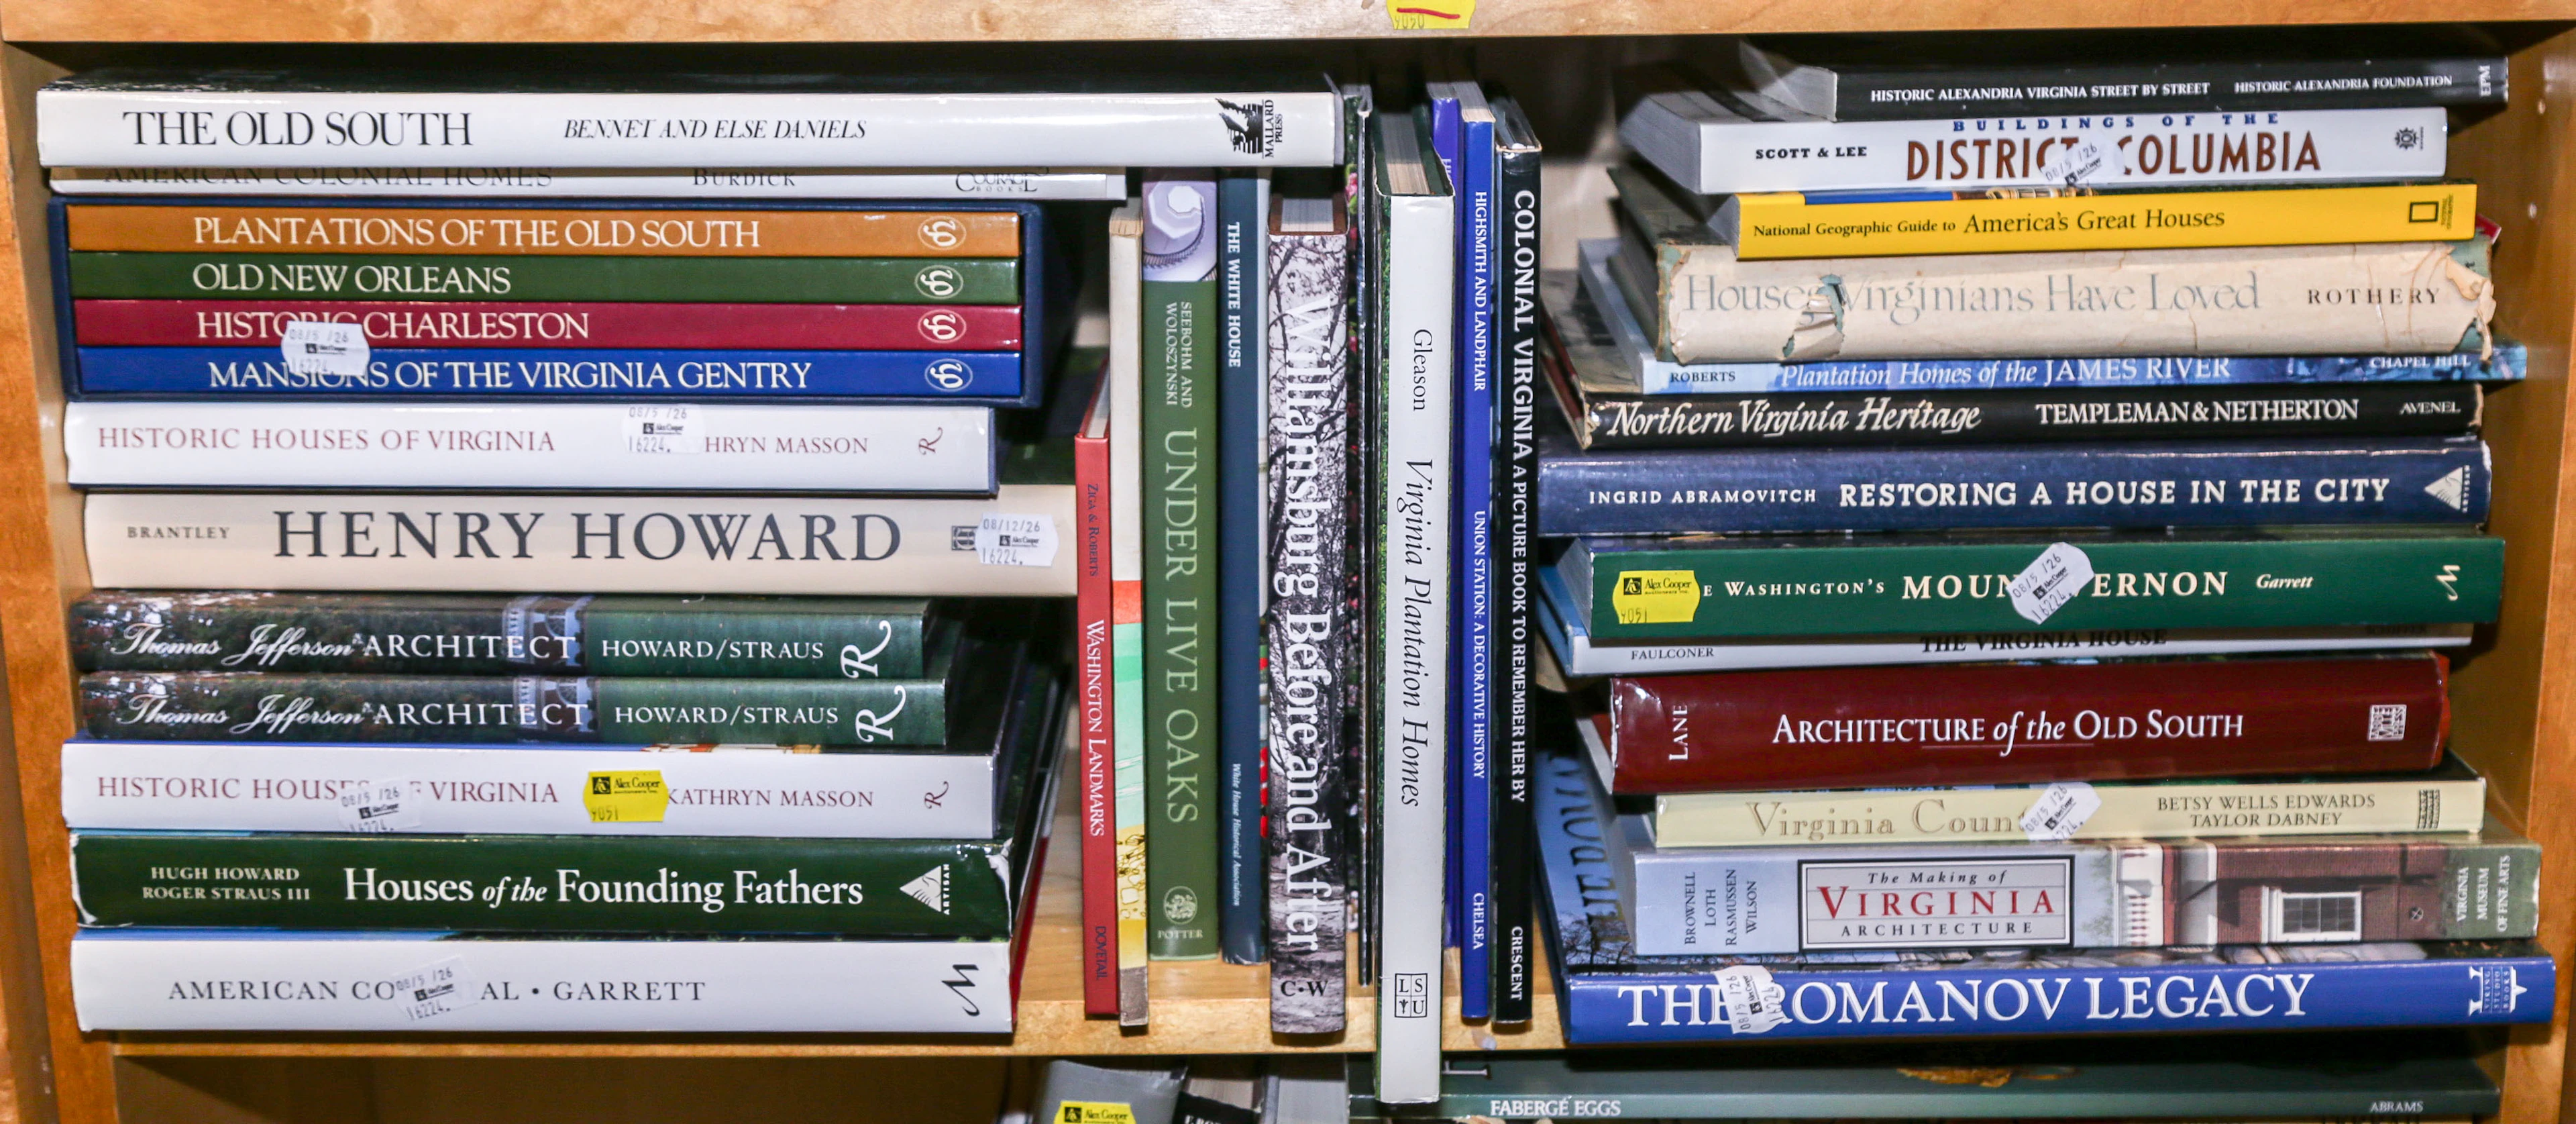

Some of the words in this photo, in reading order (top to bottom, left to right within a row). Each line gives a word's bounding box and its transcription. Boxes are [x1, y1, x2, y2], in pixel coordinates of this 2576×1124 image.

[1871, 89, 1935, 102] HISTORIC
[1938, 87, 2023, 101] ALEXANDRIA
[2027, 86, 2087, 99] VIRGINIA
[2091, 85, 2138, 97] STREET
[2146, 84, 2160, 96] BY
[2163, 82, 2210, 95] STREET
[2235, 81, 2292, 93] HISTORIC
[2294, 78, 2369, 91] ALEXANDRIA
[2373, 75, 2453, 89] FOUNDATION
[123, 111, 216, 146] THE
[226, 111, 313, 146] OLD
[325, 111, 472, 146] SOUTH
[565, 119, 653, 140] BENNET
[660, 119, 706, 140] AND
[714, 119, 767, 140] ELSE
[774, 119, 867, 140] DANIELS
[1265, 99, 1275, 158] MALLARD
[1954, 117, 2134, 132] BUILDINGS
[2163, 114, 2196, 127] OF
[2222, 113, 2278, 125] THE
[1756, 147, 1811, 159] SCOTT
[1817, 147, 1830, 158] &
[1836, 146, 1868, 157] LEE
[195, 217, 433, 246] PLANTATIONS
[441, 218, 485, 246] OF
[490, 219, 558, 246] THE
[565, 219, 635, 248] OLD
[641, 219, 761, 248] SOUTH
[1228, 222, 1240, 252] THE
[1475, 191, 1487, 272] HIGHSMITH
[1754, 223, 1811, 237] National
[1816, 220, 1892, 238] Geographic
[1897, 219, 1937, 233] Guide
[1943, 219, 1955, 231] to
[1964, 211, 2068, 234] America's
[2078, 209, 2136, 232] Great
[2145, 209, 2225, 229] Houses
[193, 264, 262, 291] OLD
[270, 265, 348, 292] NEW
[355, 265, 511, 294] ORLEANS
[1513, 191, 1536, 332] COLONIAL
[1228, 258, 1241, 309] WHITE
[1474, 276, 1487, 308] AND
[2047, 274, 2135, 313] Have
[2150, 272, 2259, 311] Loved
[2308, 288, 2439, 305] ROTHERY
[1181, 302, 1191, 370] SEEBOHM
[1228, 315, 1241, 368] HOUSE
[1474, 311, 1487, 391] LANDPHAIR
[395, 361, 438, 389] OF
[444, 362, 515, 389] THE
[522, 362, 671, 389] VIRGINIA
[678, 362, 812, 390] GENTRY
[1413, 329, 1433, 411] Gleason
[1670, 371, 1735, 382] ROBERTS
[1781, 364, 1890, 387] Plantation
[1898, 363, 1970, 385] Homes
[1978, 360, 2000, 389] of
[2004, 360, 2036, 382] the
[2045, 358, 2137, 384] JAMES
[2147, 357, 2231, 380] RIVER
[1181, 375, 1192, 408] AND
[1512, 338, 1534, 461] VIRGINIA
[2400, 401, 2461, 414] AVENEL
[1607, 401, 1733, 436] Northern
[1739, 399, 1849, 437] Virginia
[1856, 397, 1981, 435] Heritage
[2037, 403, 2191, 425] TEMPLEMAN
[2214, 399, 2359, 423] NETHERTON
[99, 427, 241, 450] HISTORIC
[252, 429, 368, 451] HOUSES
[381, 429, 419, 451] OF
[428, 430, 555, 452] VIRGINIA
[1273, 295, 1332, 598] Williamsburg
[1512, 464, 1526, 478] A
[1165, 427, 1197, 581] UNDER
[1589, 490, 1662, 504] INGRID
[1672, 487, 1816, 503] ABRAMOVITCH
[1840, 482, 2016, 507] RESTORING
[2031, 483, 2051, 506] A
[2067, 480, 2176, 505] HOUSE
[2191, 480, 2224, 504] IN
[2240, 479, 2300, 503] THE
[2314, 478, 2390, 503] CITY
[1397, 459, 1433, 565] Virginia
[1512, 482, 1527, 558] PICTURE
[127, 525, 229, 540] BRANTLEY
[274, 511, 545, 558] HENRY
[571, 512, 901, 561] HOWARD
[1474, 511, 1486, 555] UNION
[1473, 558, 1485, 618] STATION:
[1512, 562, 1527, 612] BOOK
[1645, 578, 1661, 589] Alex
[1663, 578, 1692, 591] Cooper
[2257, 574, 2314, 590] Garrett
[111, 622, 221, 656] Thomas
[221, 623, 353, 666] Jefferson
[363, 635, 576, 660] ARCHITECT
[1166, 598, 1198, 692] LIVE
[1403, 575, 1431, 708] Plantation
[1473, 622, 1485, 631] A
[1512, 617, 1526, 641] TO
[602, 639, 824, 660] HOWARD/STRAUS
[1631, 647, 1715, 660] FAULCONER
[1086, 620, 1104, 733] WASHINGTON
[1285, 609, 1333, 746] Before
[1473, 634, 1485, 721] DECORATIVE
[1511, 644, 1526, 737] REMEMBER
[1472, 723, 1485, 778] HISTORY
[1670, 704, 1688, 760] LANE
[1773, 714, 1985, 744] ARCHITECTURE
[1992, 711, 2024, 756] of
[2027, 711, 2065, 740] the
[2074, 711, 2137, 738] OLD
[2147, 709, 2243, 738] SOUTH
[1166, 709, 1199, 823] OAKS
[1401, 717, 1429, 807] Homes
[1511, 741, 1525, 776] HER
[1087, 739, 1106, 837] LANDMARKS
[1285, 756, 1332, 833] and
[1511, 778, 1525, 803] BY
[2158, 797, 2212, 812] BETSY
[2220, 796, 2279, 811] WELLS
[2285, 794, 2375, 810] EDWARDS
[2191, 813, 2261, 828] TAYLOR
[2268, 811, 2342, 827] DABNEY
[151, 866, 207, 880] HUGH
[215, 866, 300, 881] HOWARD
[344, 867, 474, 903] Houses
[481, 876, 512, 909] of
[512, 876, 547, 903] the
[556, 868, 724, 913] Founding
[733, 870, 863, 905] Fathers
[1868, 872, 1899, 884] The
[1910, 871, 1978, 886] Making
[1988, 869, 2008, 884] of
[142, 886, 206, 901] ROGER
[212, 886, 281, 901] STRAUS
[288, 886, 310, 901] III
[1285, 847, 1333, 952] After
[1684, 872, 1696, 946] BROWNELL
[1705, 889, 1716, 926] LOTH
[1725, 869, 1737, 946] RASMUSSEN
[1746, 880, 1758, 934] WILSON
[1817, 885, 2055, 919] VIRGINIA
[1157, 929, 1203, 939] POTTER
[1472, 892, 1485, 951] CHELSEA
[1841, 921, 2033, 937] ARCHITECTURE
[1510, 925, 1523, 1001] CRESCENT
[2086, 974, 2314, 1020] LEGACY
[1574, 1099, 1621, 1116] EGGS
[2370, 1101, 2424, 1113] ABRAMS
